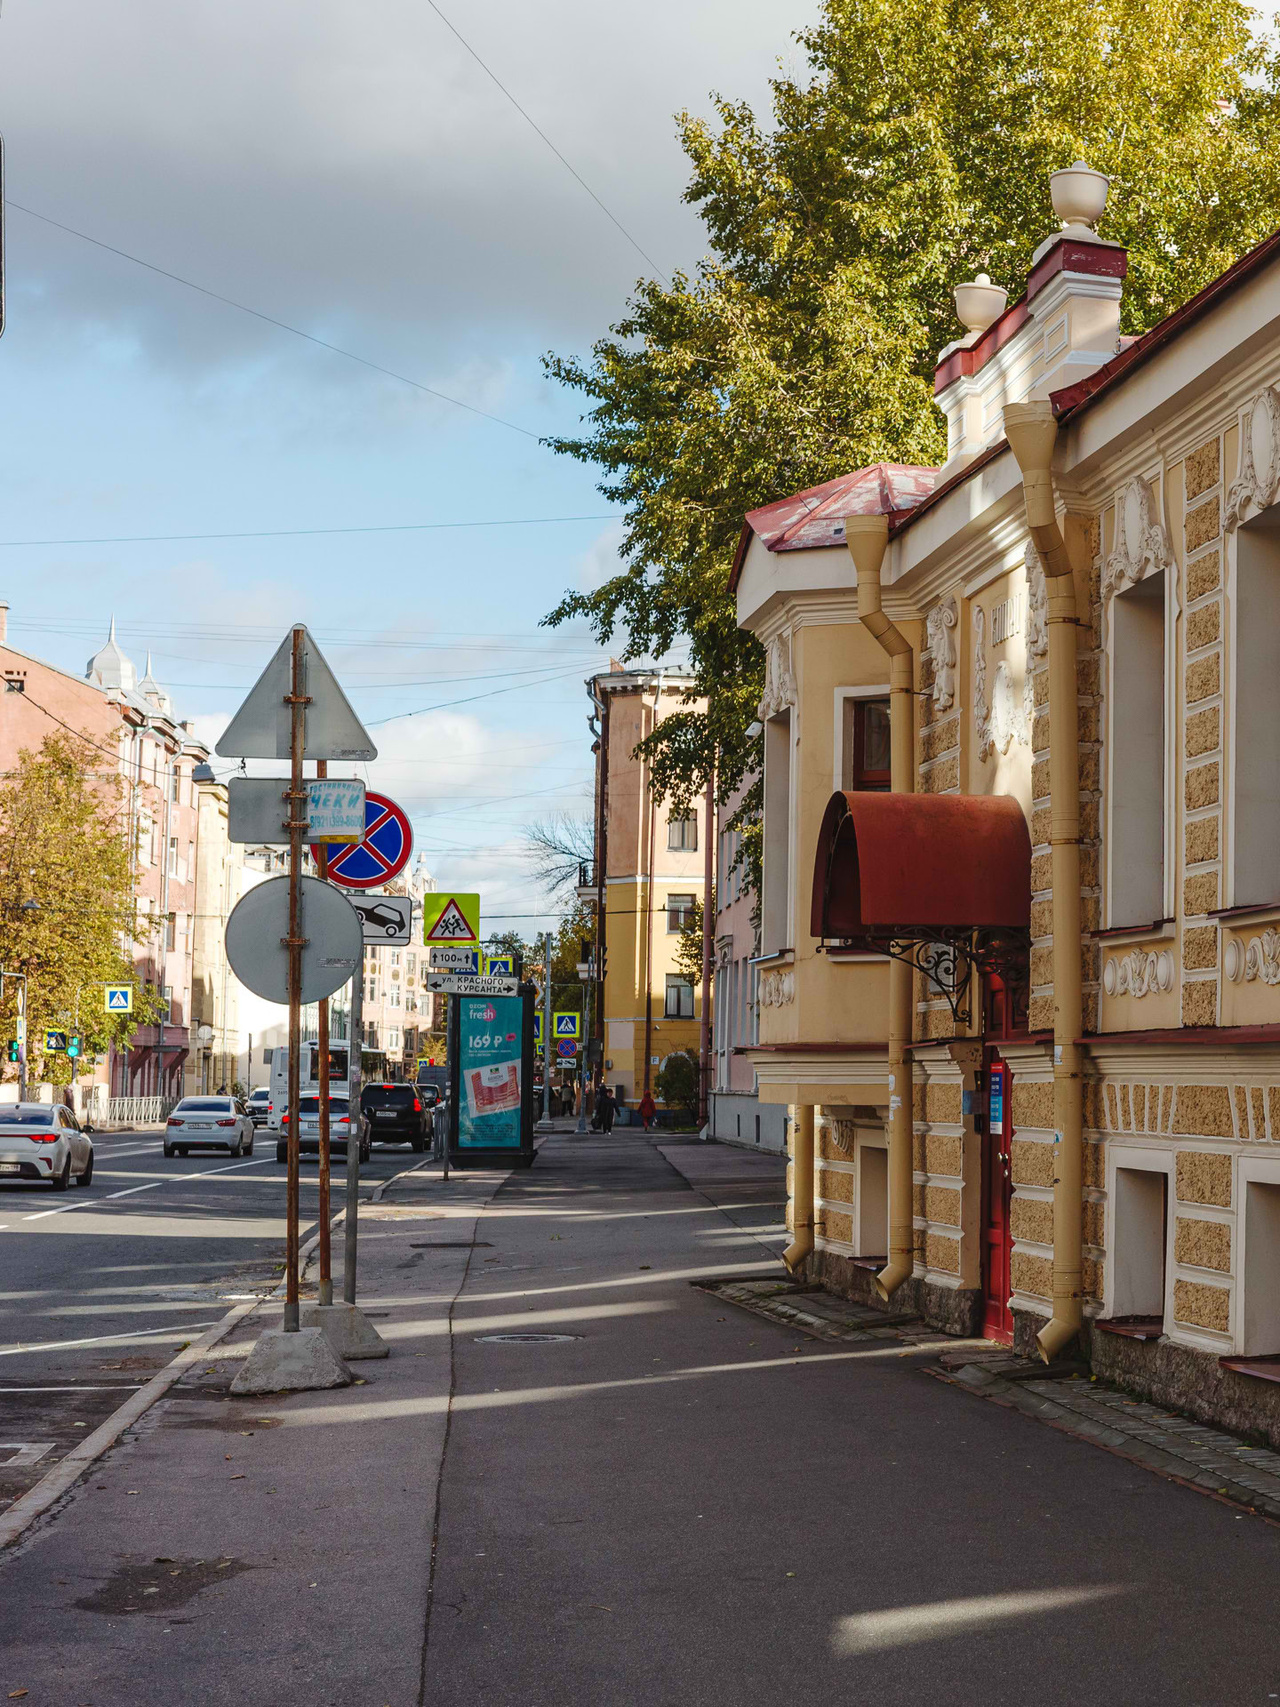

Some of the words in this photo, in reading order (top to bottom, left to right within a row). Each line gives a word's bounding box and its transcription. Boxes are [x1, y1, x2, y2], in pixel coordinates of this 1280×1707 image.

[310, 793, 361, 809] ЧЕКИ
[442, 976, 454, 984] ул.
[457, 976, 504, 986] КРАСНОГО
[457, 985, 504, 994] КУРСАНТА
[469, 1010, 494, 1020] fresh
[469, 1035, 492, 1048] 169
